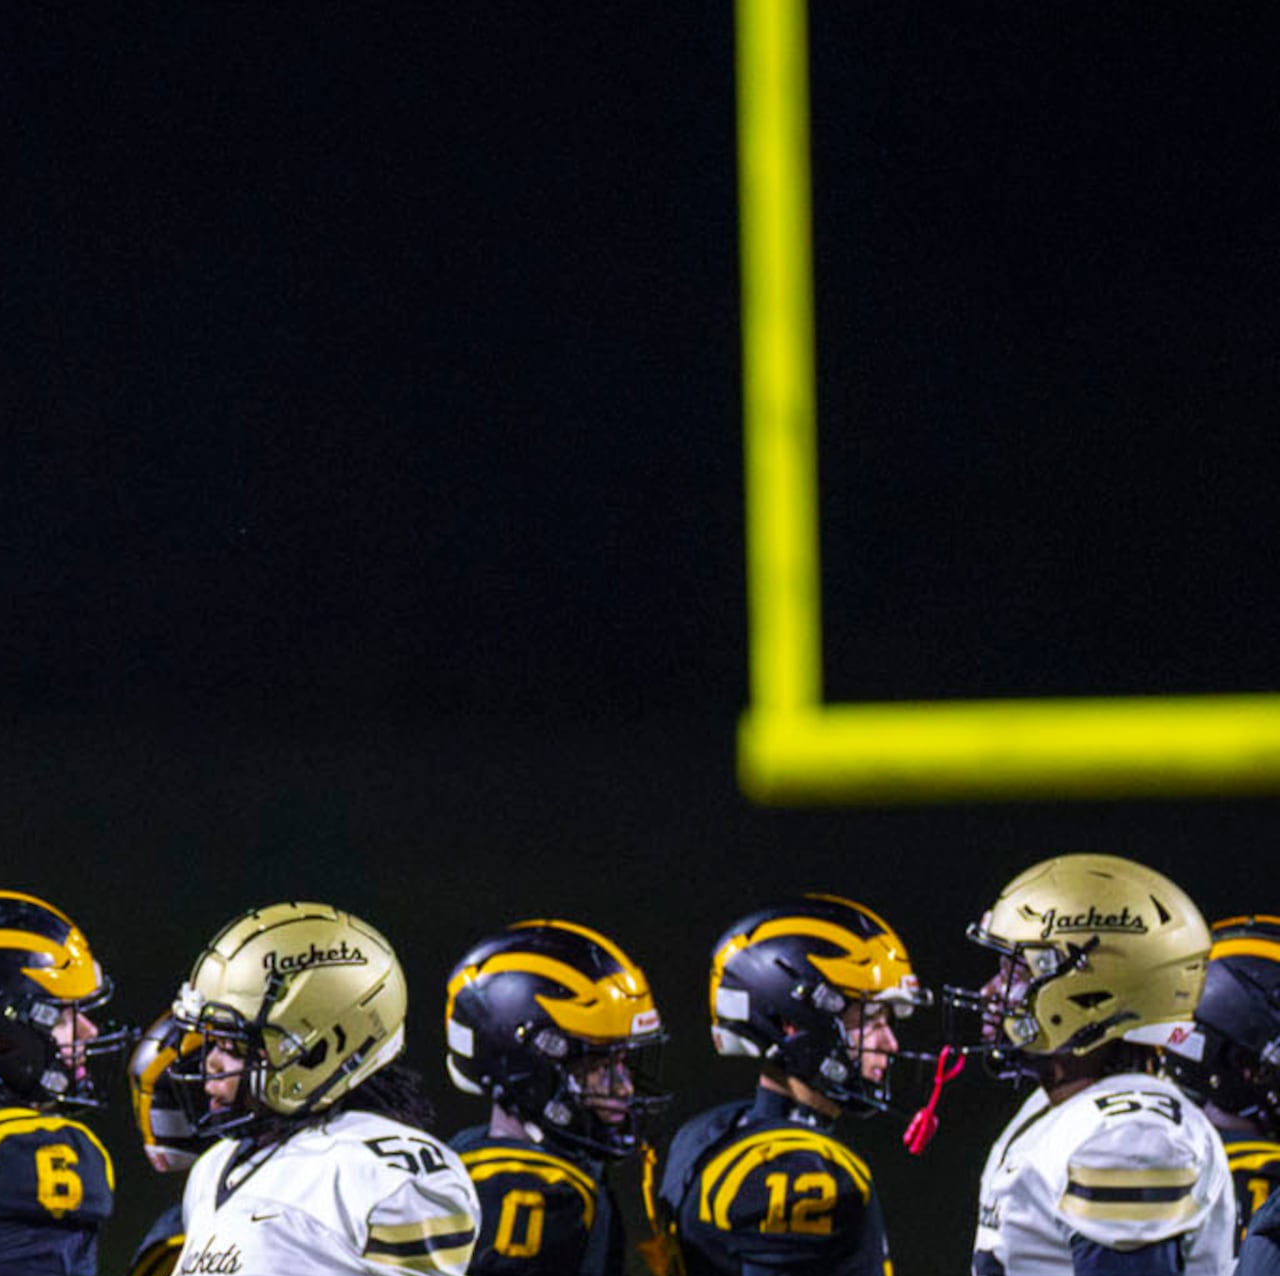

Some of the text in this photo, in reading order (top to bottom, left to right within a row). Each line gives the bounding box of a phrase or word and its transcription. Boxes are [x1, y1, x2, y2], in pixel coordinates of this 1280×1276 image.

[1040, 906, 1148, 938] Jackets
[263, 941, 368, 982] Jackets
[1094, 1090, 1183, 1126] 53
[35, 1144, 82, 1212] 6
[494, 1190, 545, 1257] 0
[760, 1172, 838, 1235] 12
[181, 1235, 241, 1275] ckets
